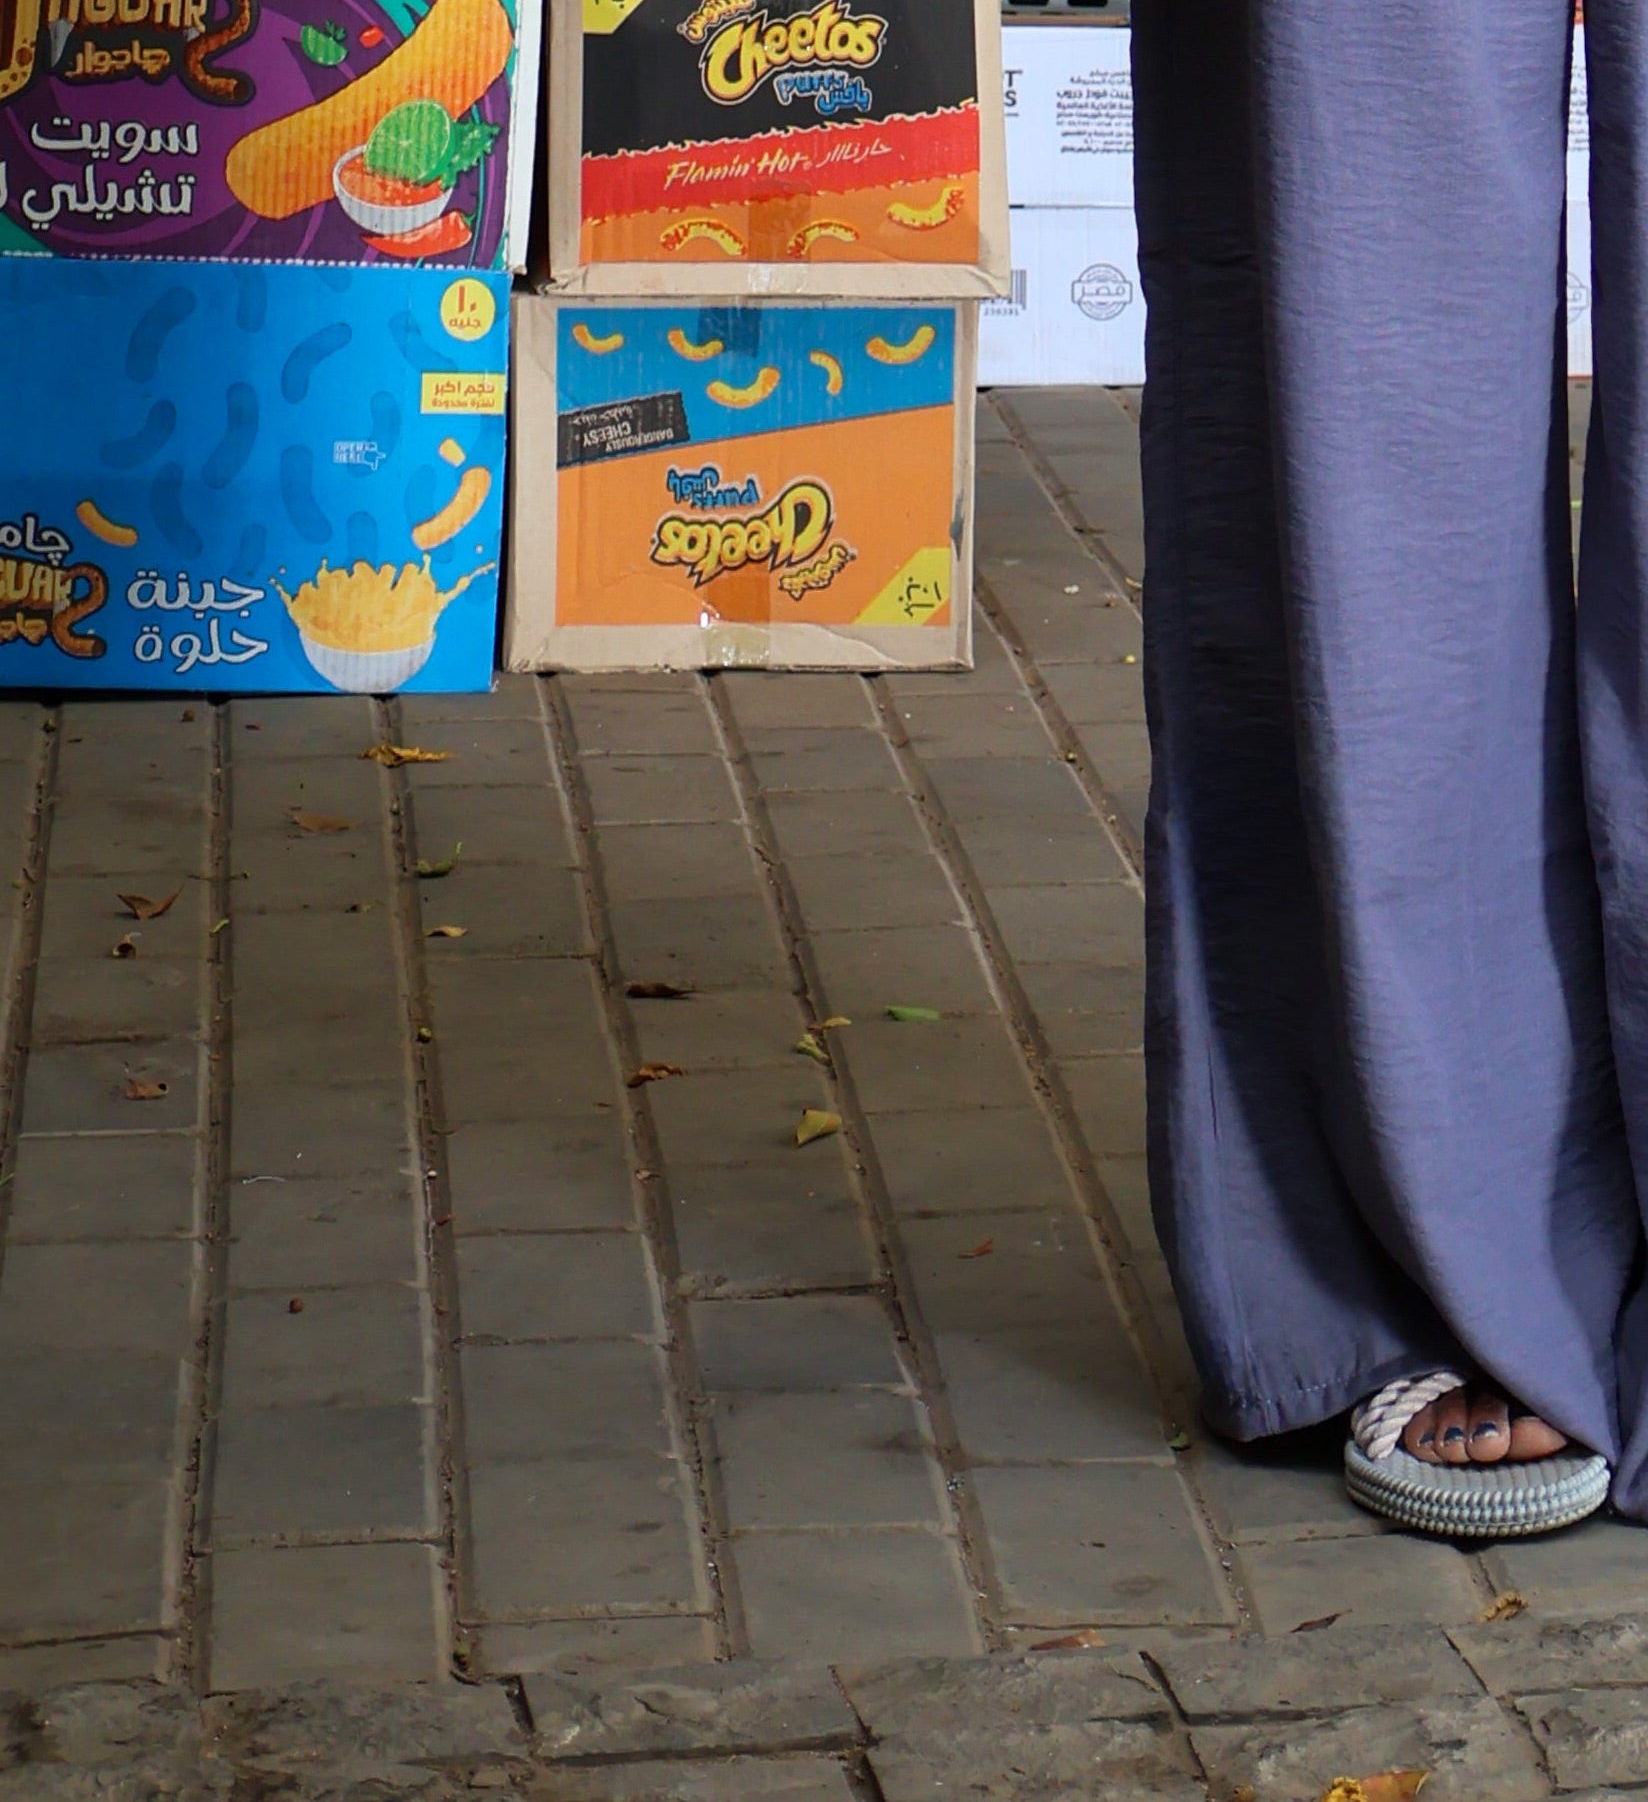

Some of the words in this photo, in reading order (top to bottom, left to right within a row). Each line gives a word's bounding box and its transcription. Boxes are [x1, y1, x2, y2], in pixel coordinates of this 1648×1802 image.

[705, 2, 883, 103] Cheetos
[31, 117, 198, 161] سويت
[757, 149, 804, 179] Hot
[22, 170, 195, 230] تشيلي
[583, 421, 631, 447] CHEESY
[605, 429, 674, 452] DANGEROUSLY
[652, 484, 831, 584] Cheetos
[128, 569, 265, 618] جبنة
[135, 619, 269, 674] حلوة
